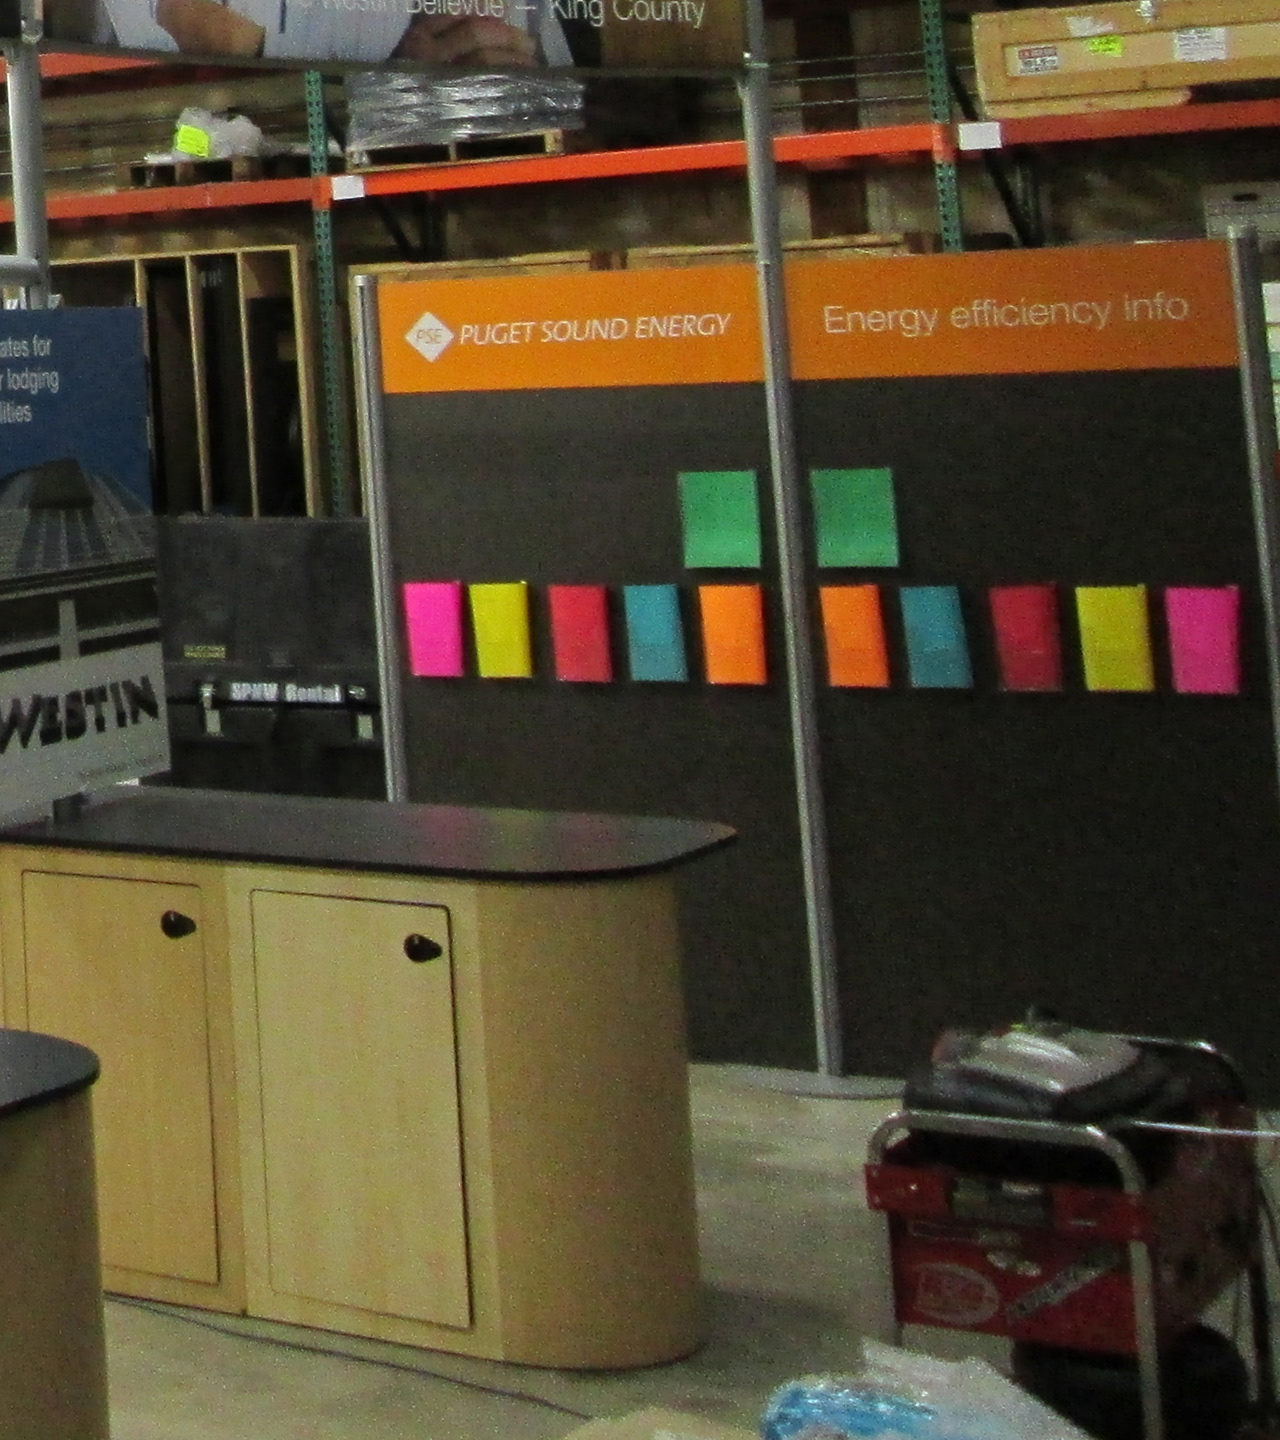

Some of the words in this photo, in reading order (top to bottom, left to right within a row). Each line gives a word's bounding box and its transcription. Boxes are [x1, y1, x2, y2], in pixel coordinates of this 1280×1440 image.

[415, 327, 443, 345] PSE
[460, 321, 536, 345] PUGET
[540, 317, 628, 342] SOUND
[634, 313, 731, 339] ENERGY
[823, 304, 937, 337] Energy
[950, 297, 1111, 330] efficiency
[1124, 291, 1190, 322] info
[33, 334, 52, 357] for
[6, 367, 60, 395] lodging
